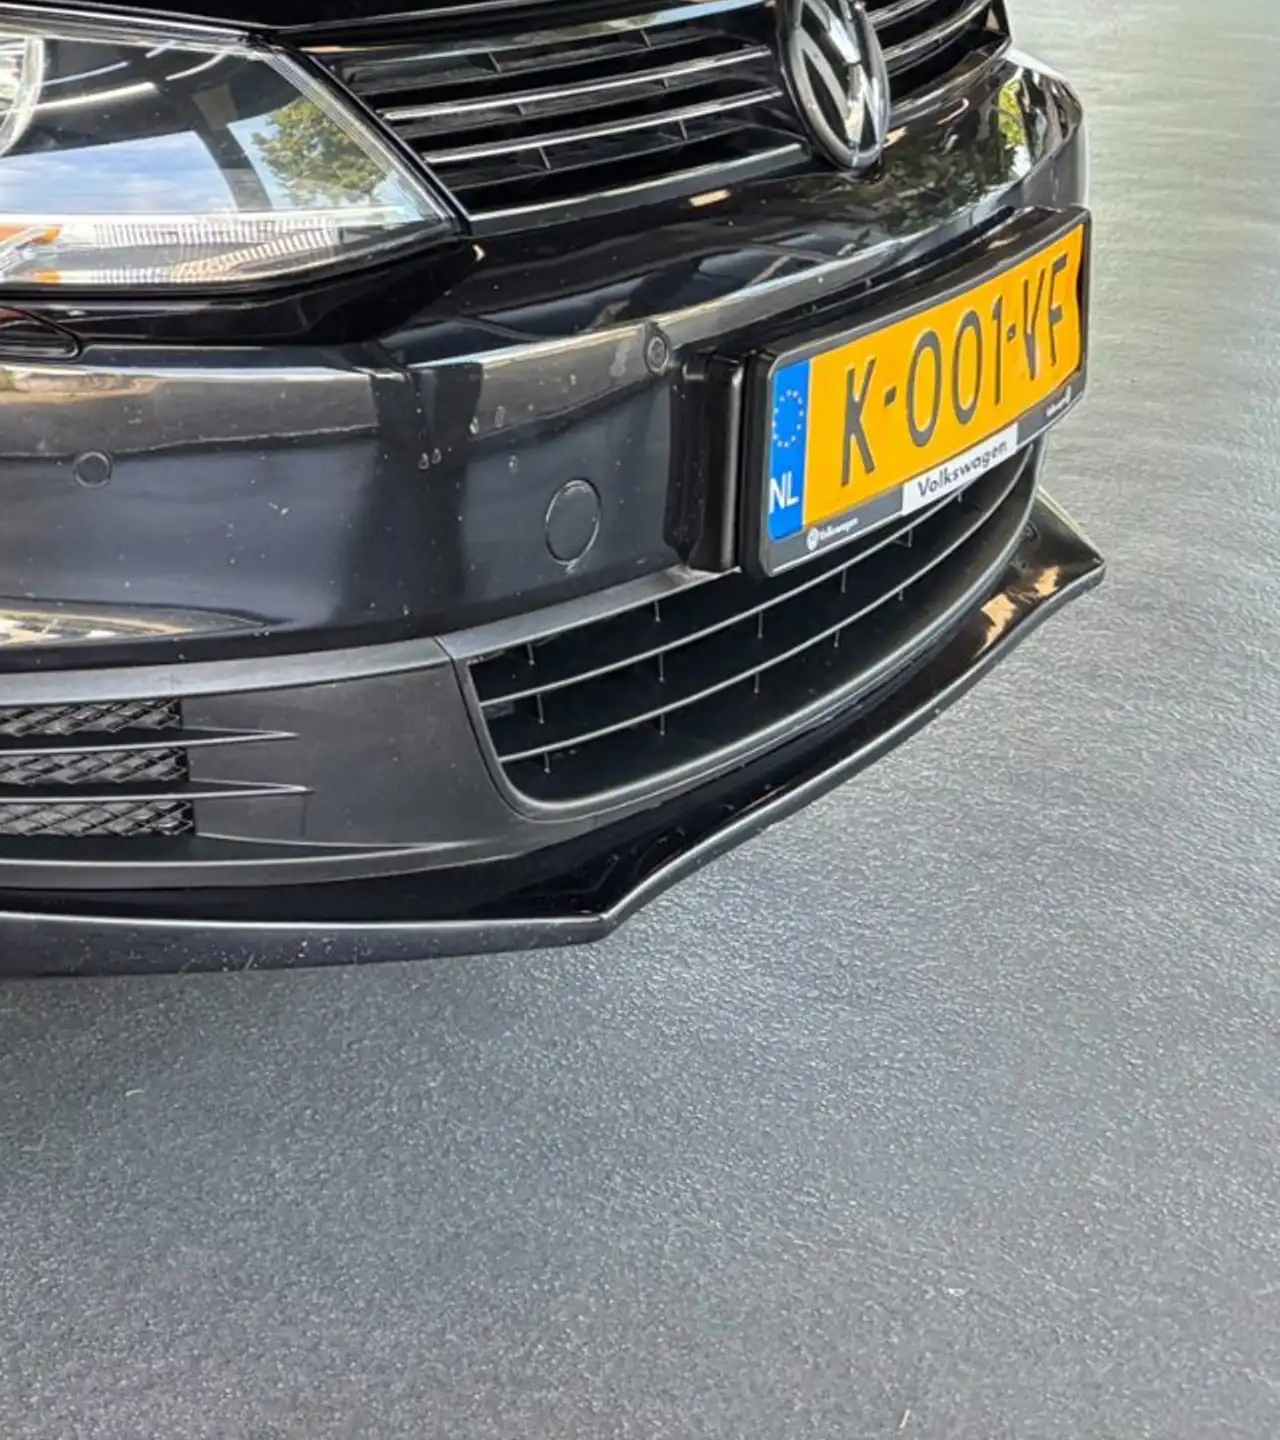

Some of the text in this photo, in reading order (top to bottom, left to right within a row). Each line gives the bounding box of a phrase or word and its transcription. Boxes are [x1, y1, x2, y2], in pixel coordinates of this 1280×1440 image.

[840, 251, 1069, 487] K-001-VF
[769, 475, 800, 514] NL
[917, 439, 1008, 498] Volkswagen
